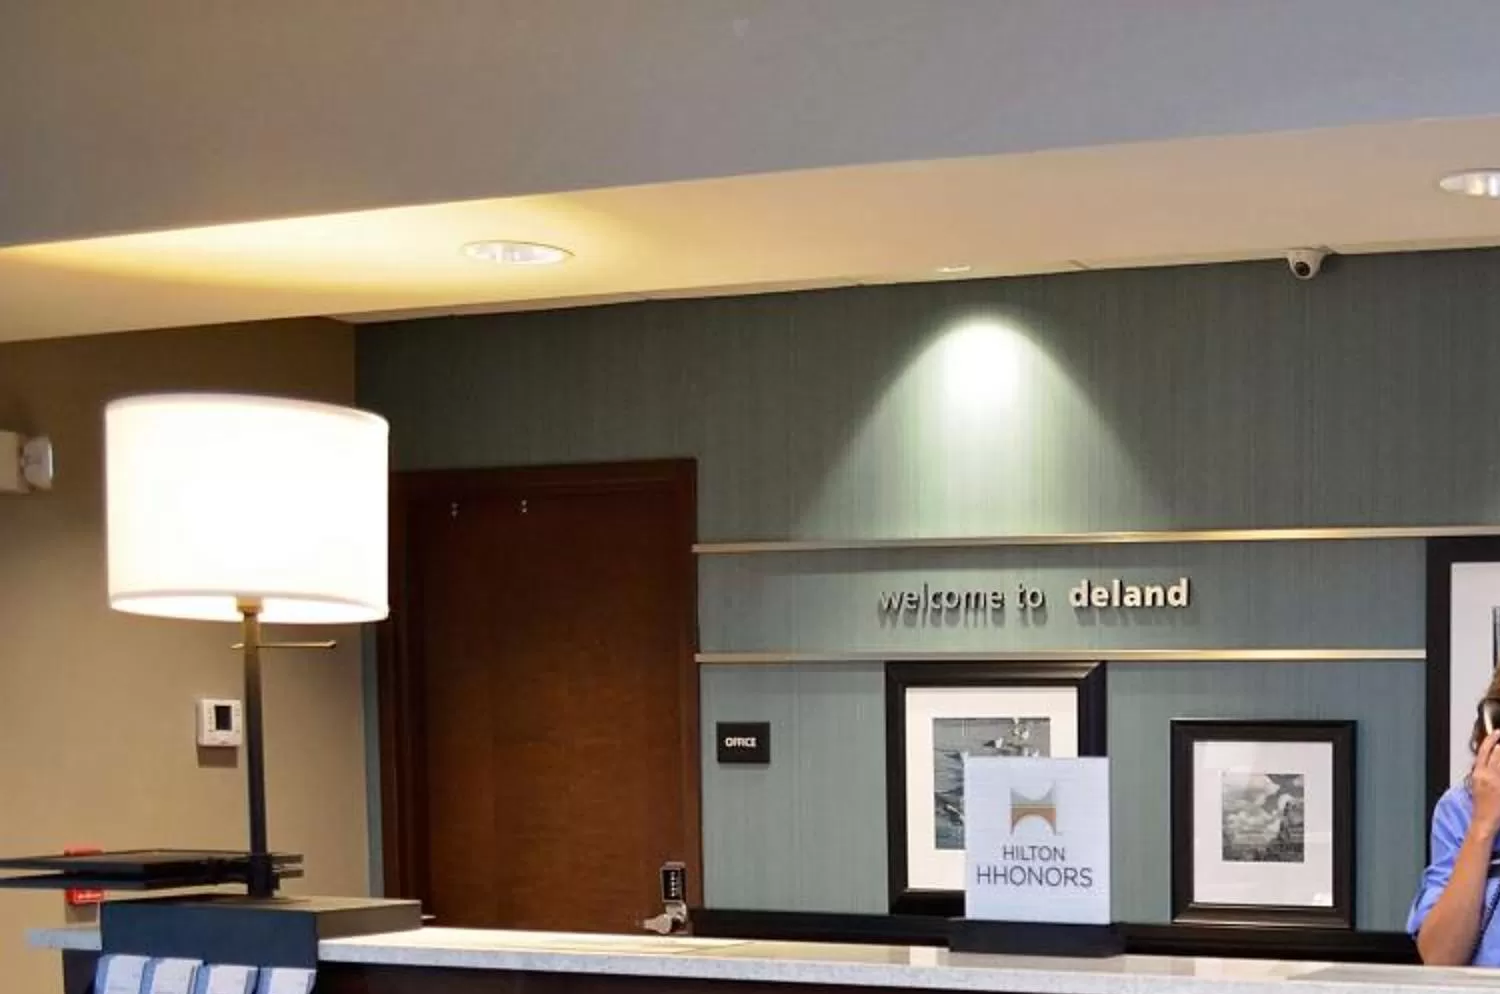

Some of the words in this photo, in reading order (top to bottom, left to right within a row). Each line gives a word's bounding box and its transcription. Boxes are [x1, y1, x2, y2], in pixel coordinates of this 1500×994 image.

[878, 582, 1004, 609] welcome
[1016, 584, 1046, 607] to
[1069, 578, 1191, 607] deland
[1003, 845, 1065, 862] HILTON
[977, 865, 1093, 887] HHONORS
